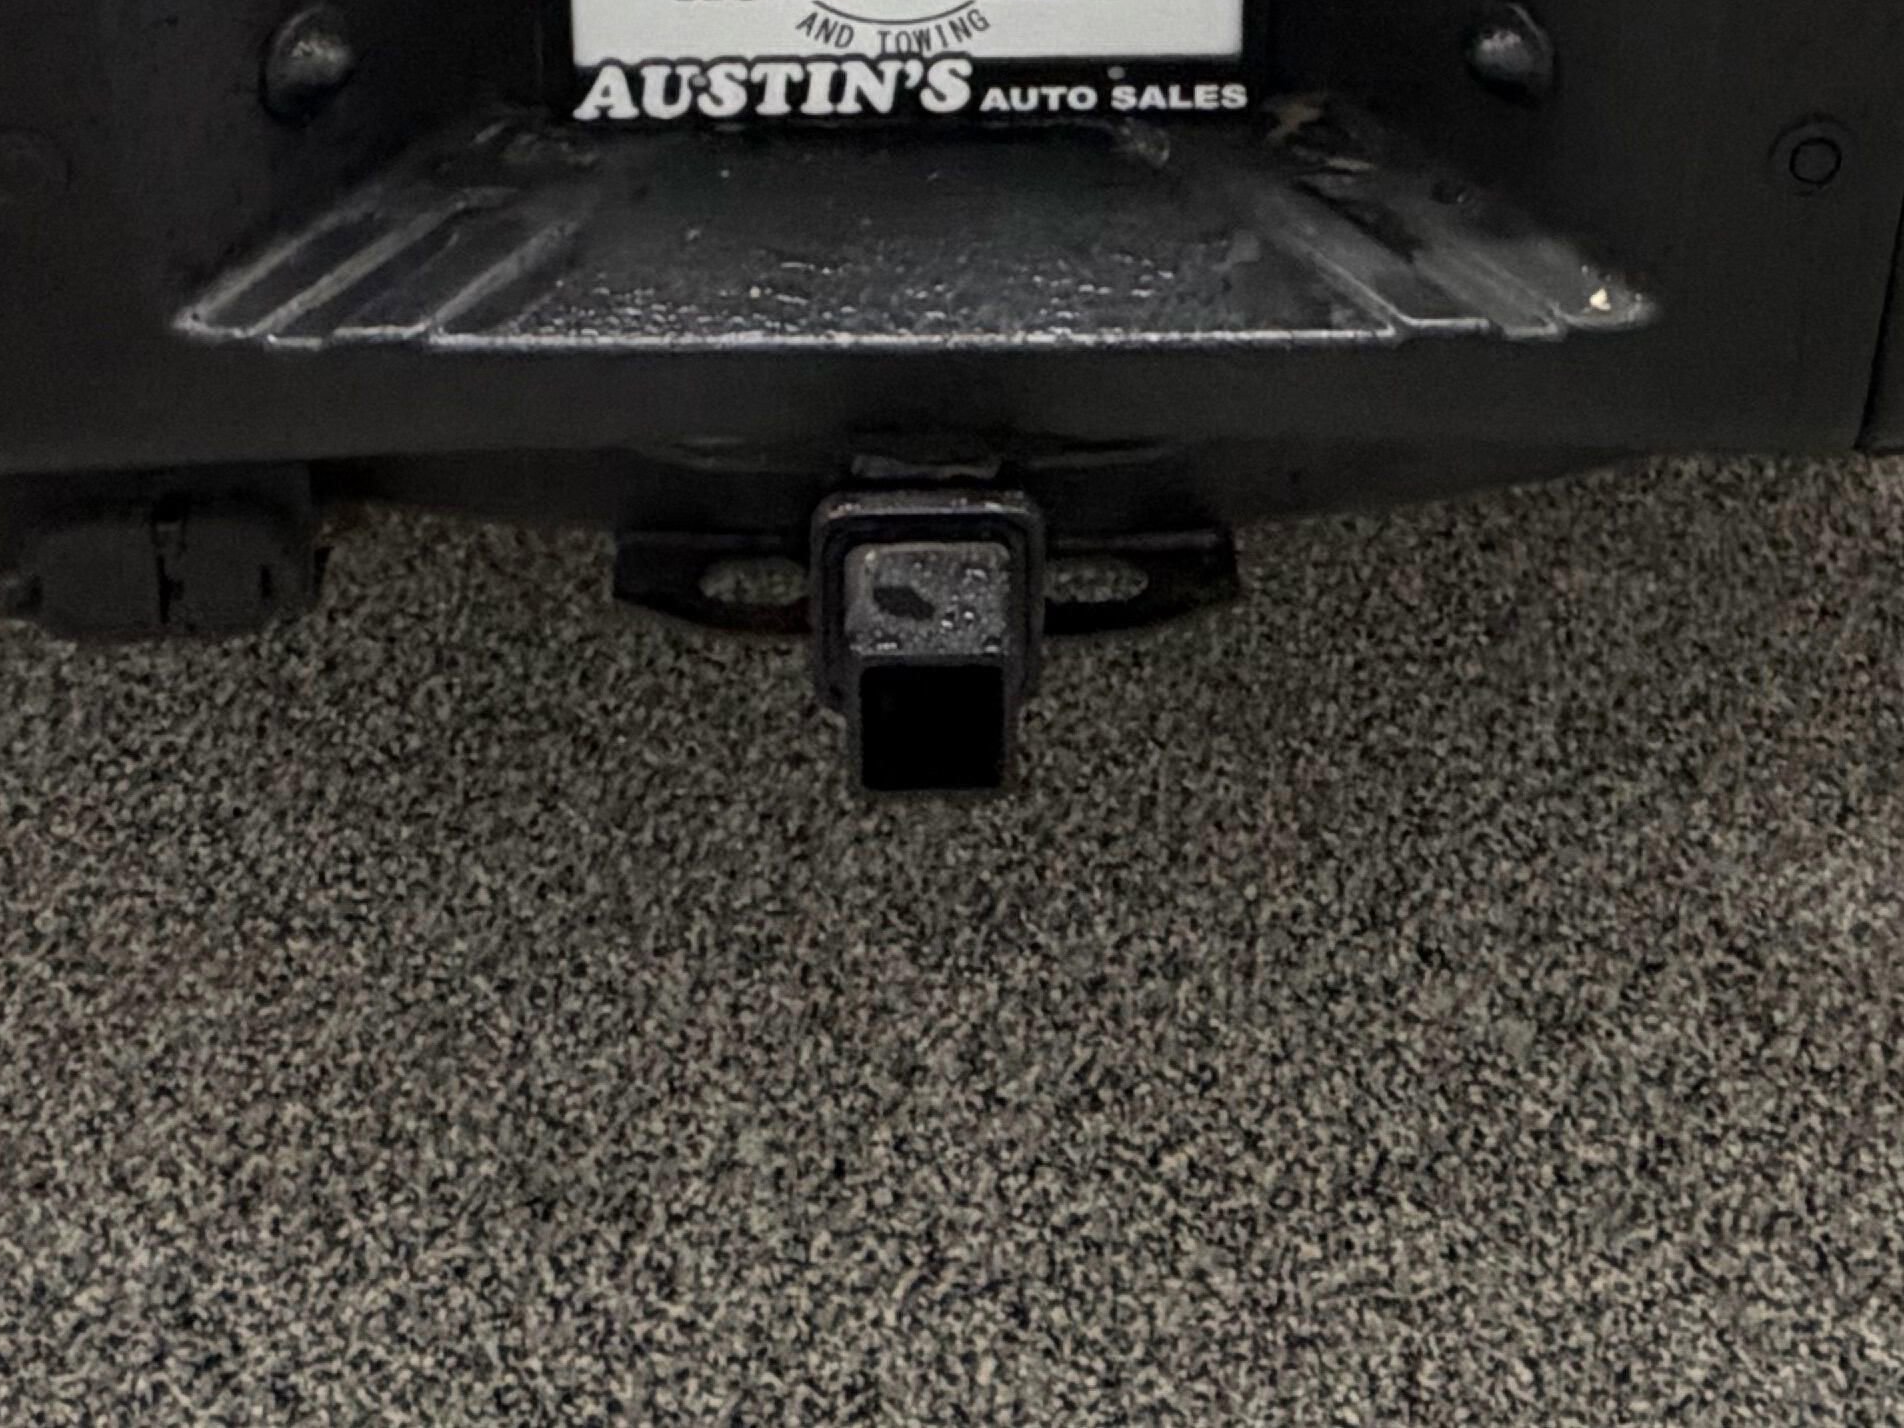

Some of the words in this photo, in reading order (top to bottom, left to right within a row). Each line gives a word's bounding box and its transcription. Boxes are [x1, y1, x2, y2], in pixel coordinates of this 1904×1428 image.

[795, 11, 855, 49] AND
[877, 8, 991, 55] TOWING
[572, 59, 976, 121] AUSTIN'S
[980, 86, 1098, 112] AUTO
[1111, 84, 1249, 112] SALES
